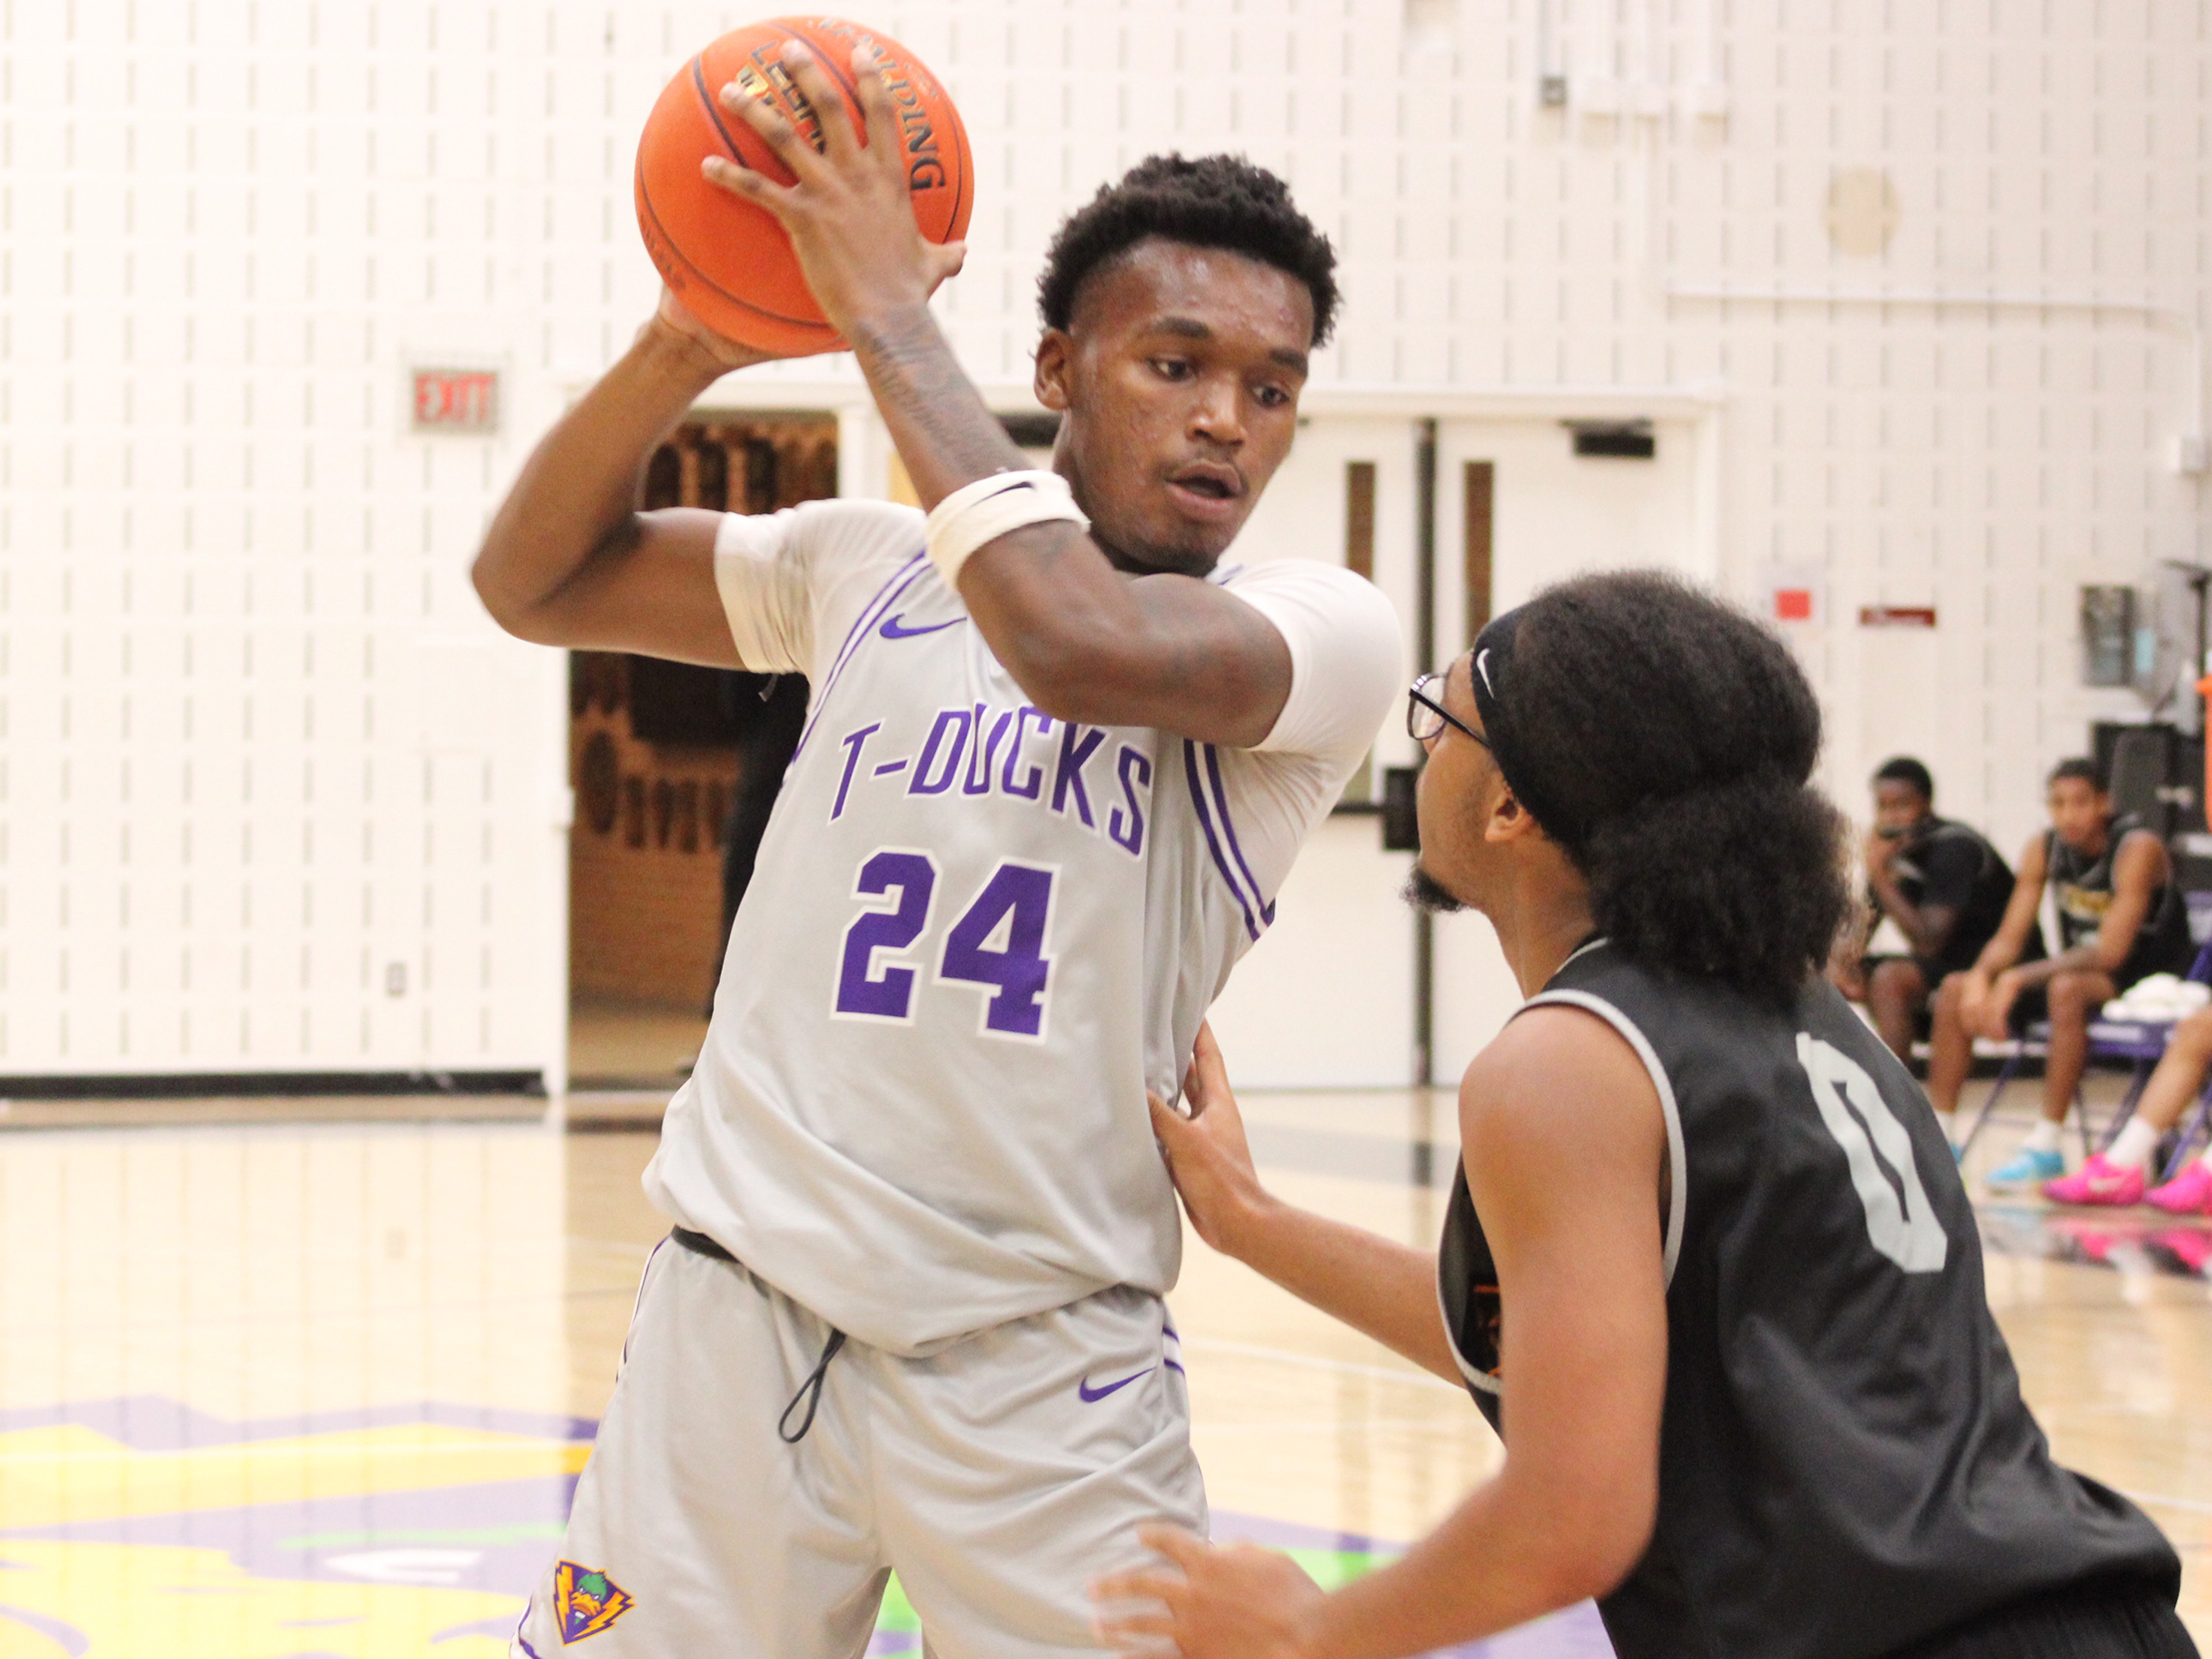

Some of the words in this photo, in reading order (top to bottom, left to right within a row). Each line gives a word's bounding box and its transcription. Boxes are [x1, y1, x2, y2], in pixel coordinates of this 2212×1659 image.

[415, 371, 496, 424] EXIT
[828, 702, 1152, 860] T-DUCKS
[830, 845, 1062, 1045] 24
[1796, 1031, 1947, 1273] 0
